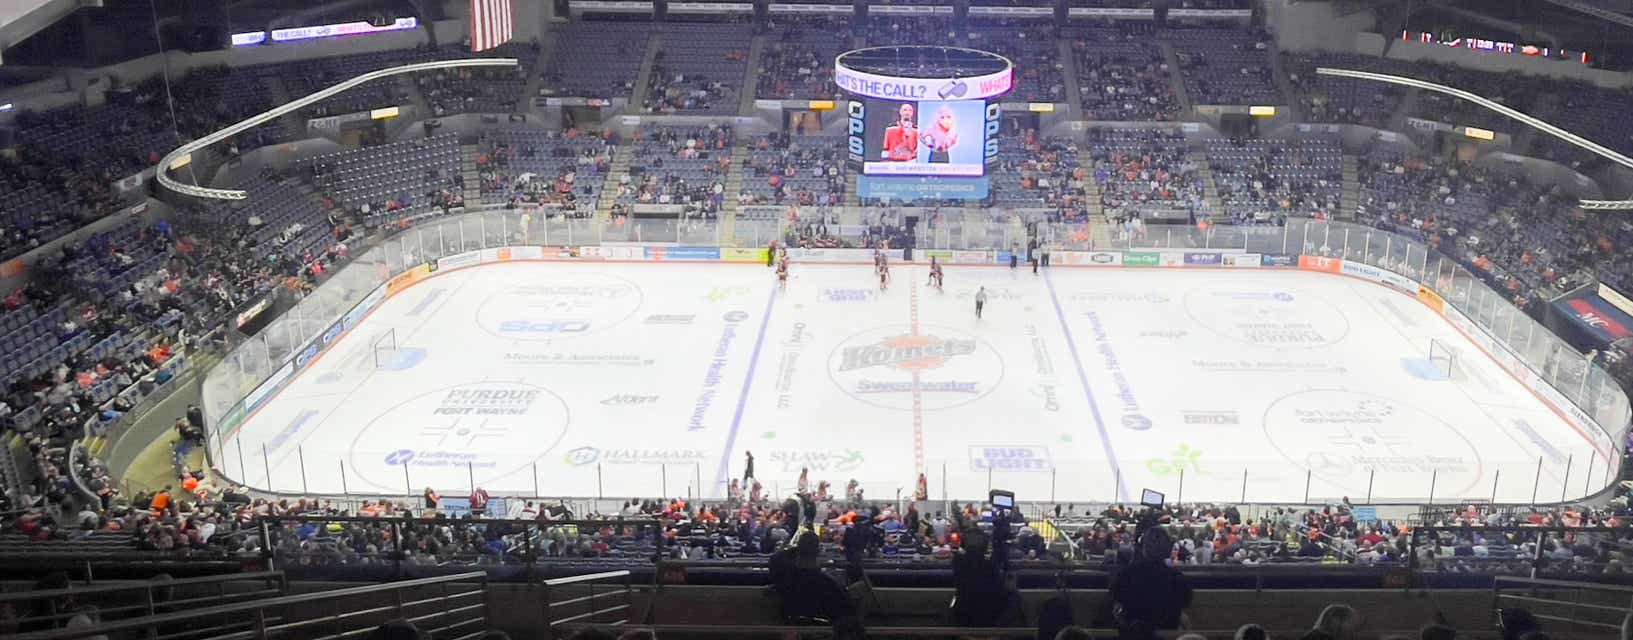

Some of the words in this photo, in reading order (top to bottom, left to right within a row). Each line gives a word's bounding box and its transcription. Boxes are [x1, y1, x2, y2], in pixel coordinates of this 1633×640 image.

[858, 79, 883, 94] THE
[883, 82, 927, 98] CALL?
[849, 101, 864, 155] OPS
[985, 103, 1000, 155] OPS
[838, 337, 977, 371] Komets
[857, 378, 977, 392] Sweetwater
[447, 389, 540, 400] PURDUE
[433, 407, 474, 416] FORT
[476, 407, 529, 416] WAYNE
[603, 449, 707, 460] HALLMARK
[769, 450, 831, 462] SHAW
[983, 447, 1034, 458] BUD
[974, 458, 1046, 470] LIGHT
